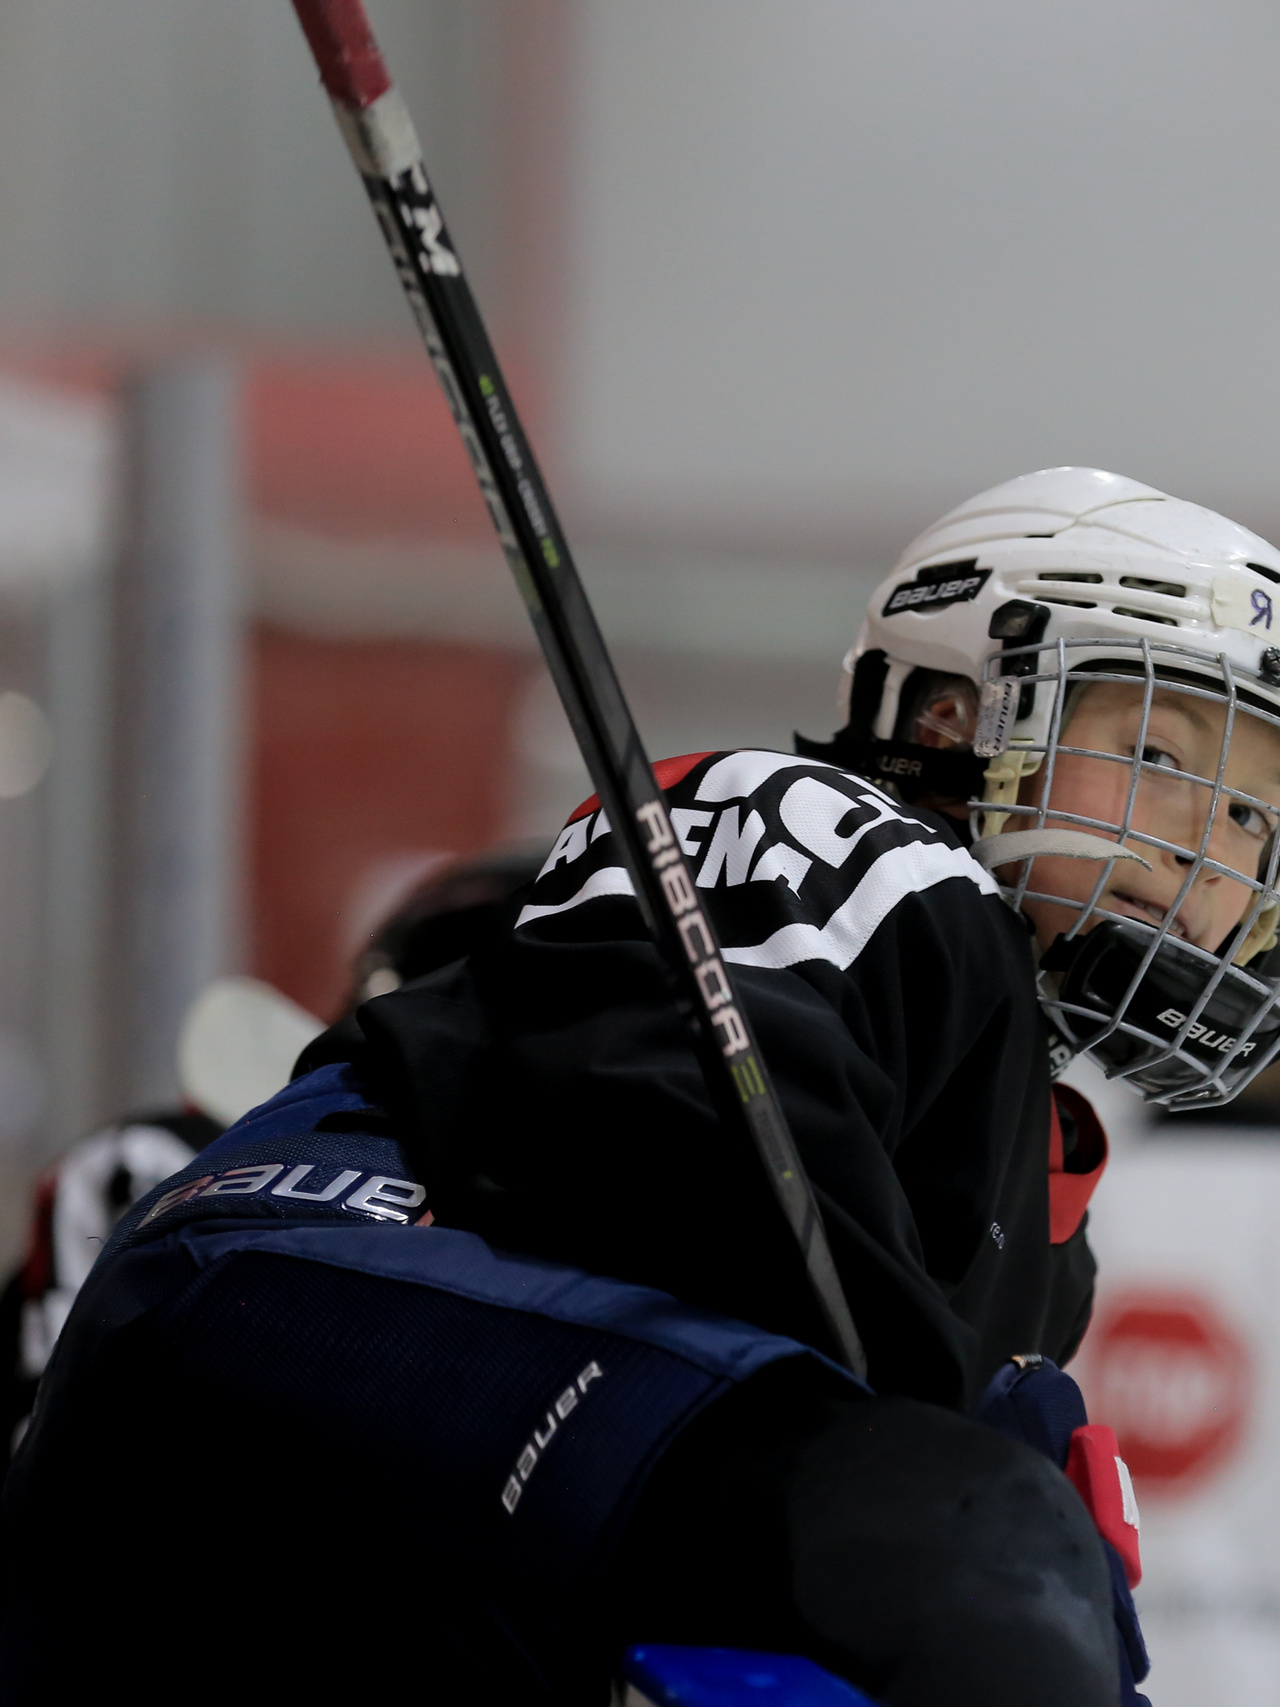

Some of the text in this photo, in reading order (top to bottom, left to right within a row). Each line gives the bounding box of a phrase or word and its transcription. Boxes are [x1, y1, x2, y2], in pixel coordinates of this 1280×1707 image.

[888, 577, 981, 609] BAUER
[636, 800, 750, 1058] RIBCOR
[1156, 1008, 1257, 1058] BAUER
[135, 1163, 435, 1230] BAUE
[501, 1360, 603, 1515] BAUER
